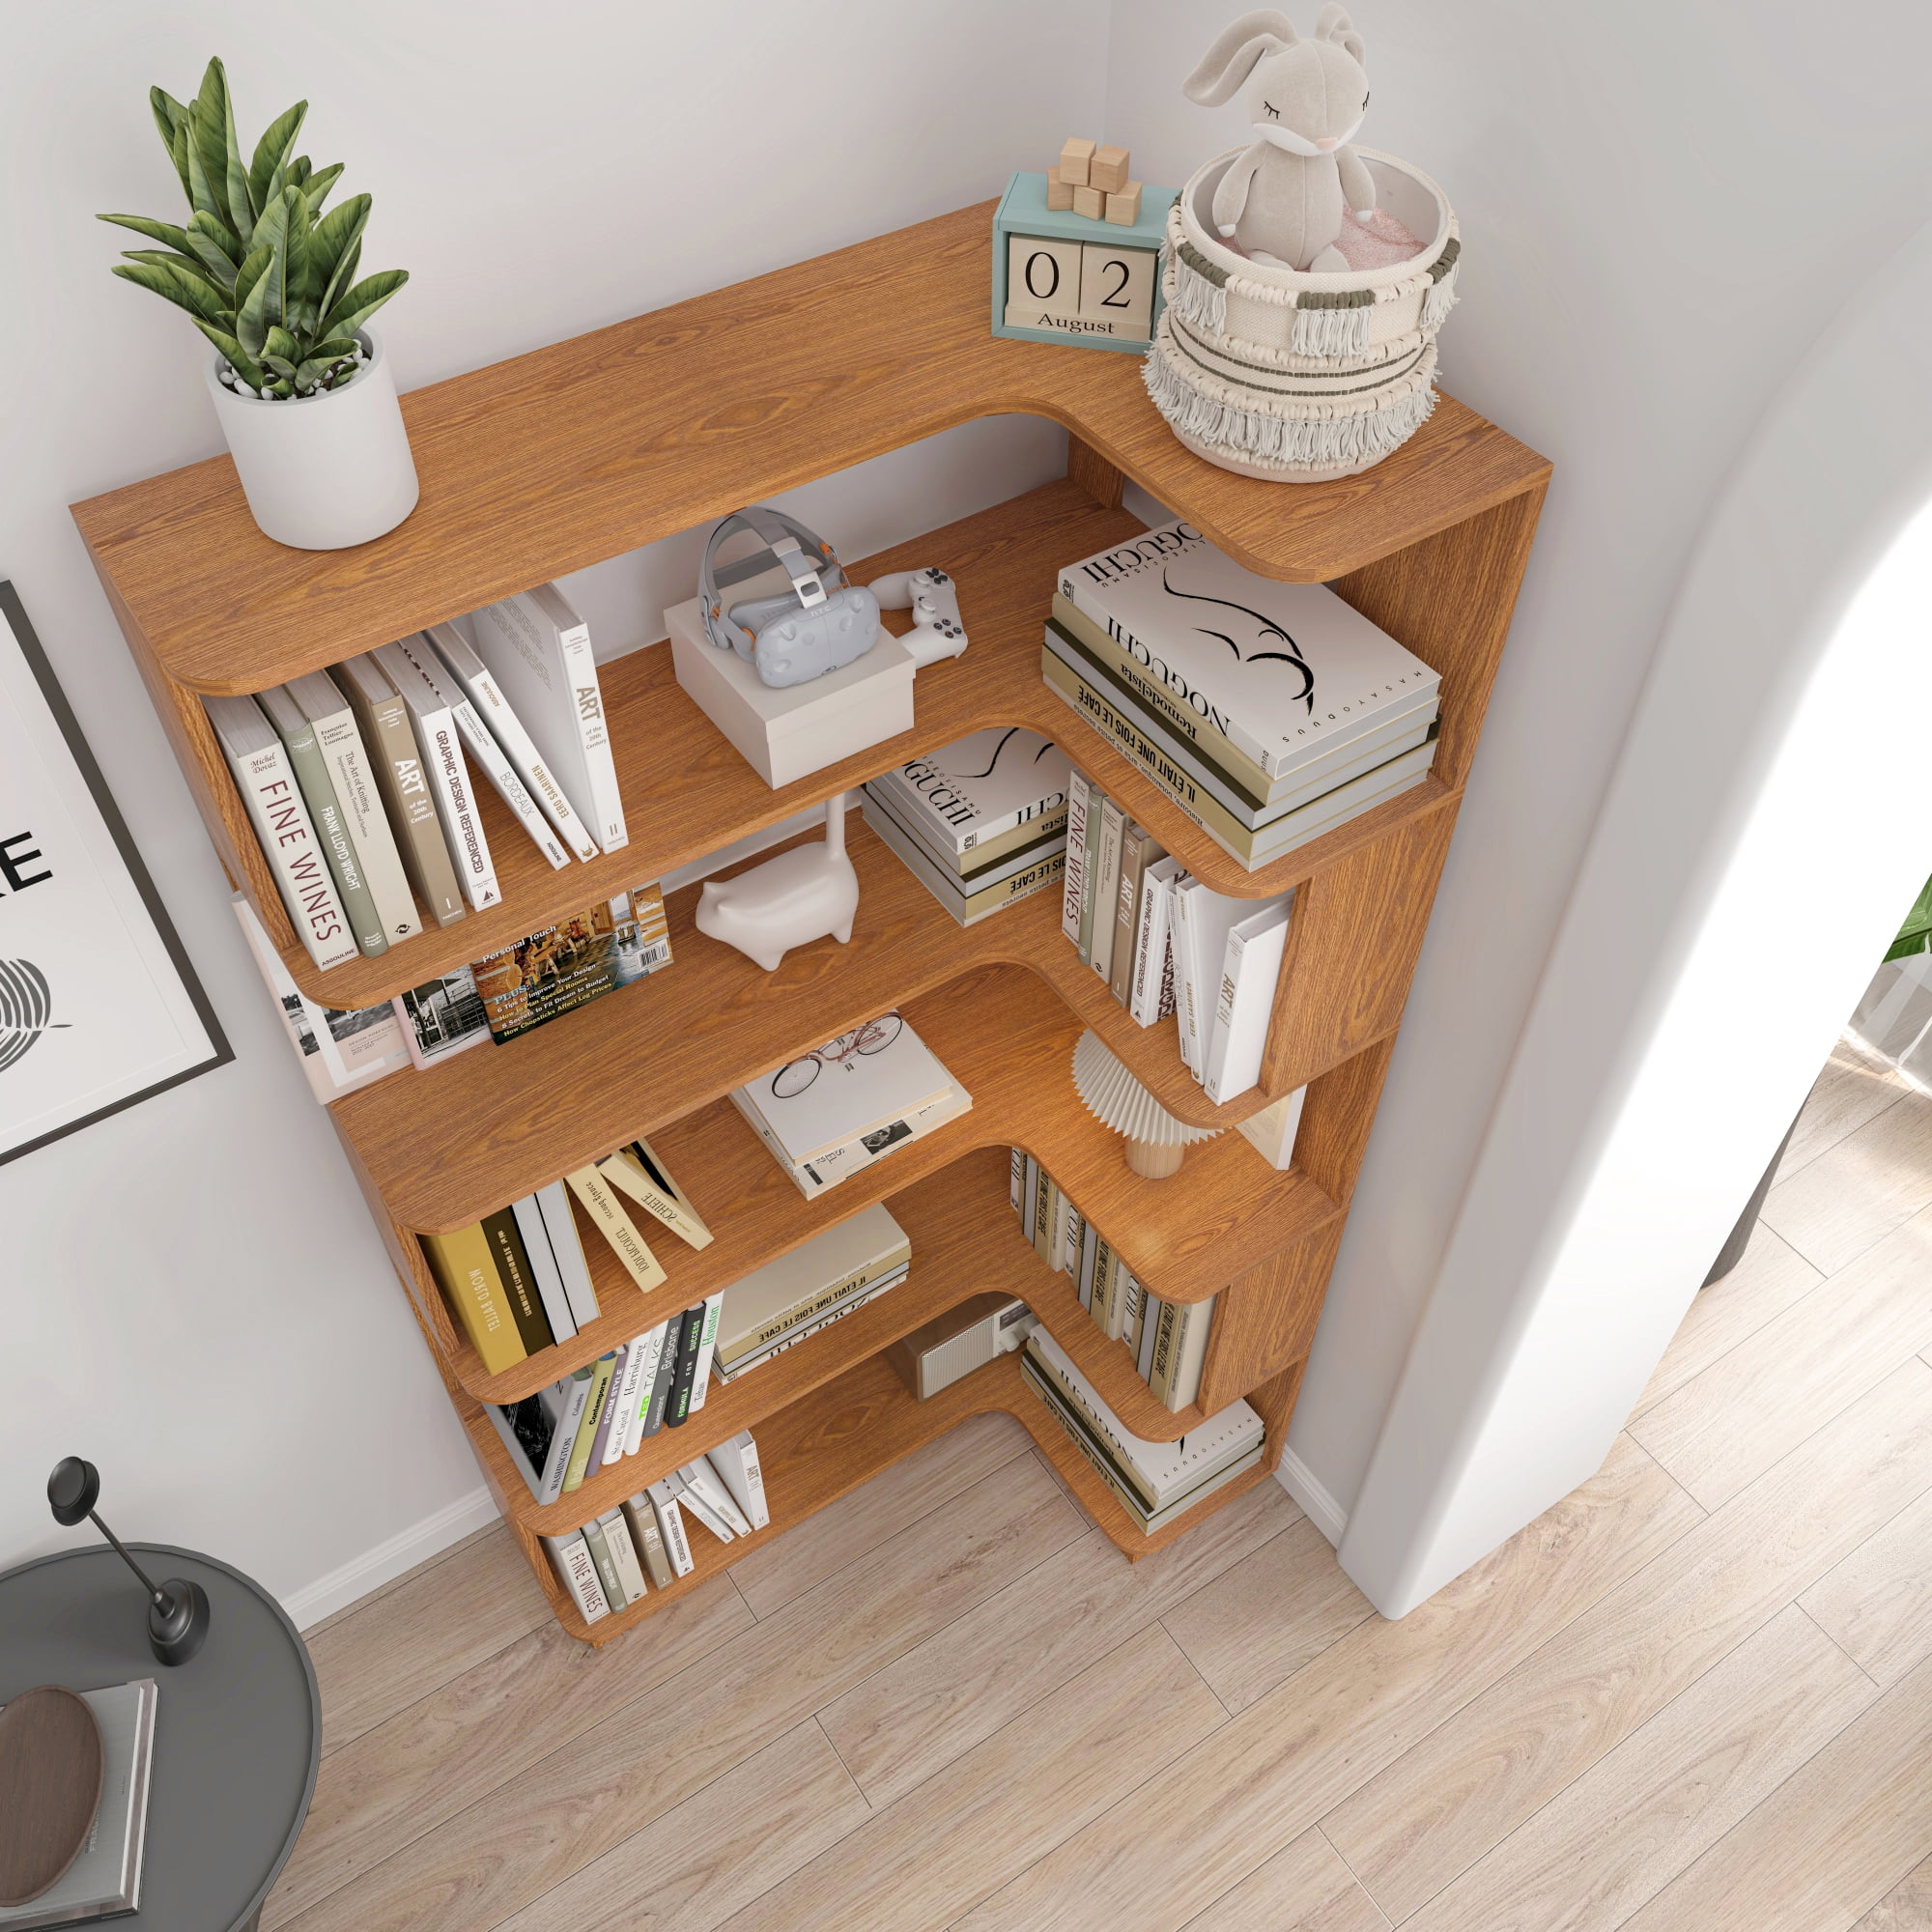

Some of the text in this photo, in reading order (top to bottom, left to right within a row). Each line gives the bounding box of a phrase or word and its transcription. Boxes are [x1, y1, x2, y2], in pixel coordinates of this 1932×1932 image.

[1037, 313, 1115, 334] August
[1081, 523, 1203, 583] OGUCHI
[1108, 615, 1232, 738] NOGUCHI
[1121, 663, 1198, 741] Remodelista
[576, 687, 601, 722] ART
[585, 727, 594, 736] of
[585, 738, 607, 750] Century
[1077, 685, 1196, 803] IL ÉTAIT UNE FOIS LE CAFÉ
[250, 752, 276, 770] Michel
[253, 760, 277, 774] Dovaz
[345, 751, 371, 814] The Art of Knitting
[394, 759, 425, 795] ART
[409, 802, 417, 810] of
[411, 810, 434, 825] Century
[412, 806, 428, 815] 20th
[436, 730, 458, 776] GRAPHIC
[449, 776, 467, 813] DESIGN
[459, 813, 485, 874] REFERENCED
[499, 771, 535, 818] BORDEAUX
[532, 764, 570, 819] EERO SAARINEN
[901, 759, 976, 827] GUCHI
[321, 806, 361, 892] FRANK LLOYD WRIGHT
[1070, 799, 1086, 853] FINE
[0, 831, 53, 892] E
[260, 780, 342, 941] FINE WINES
[1009, 863, 1050, 895] LE CAFÉ
[1066, 856, 1082, 925] WINES
[1118, 873, 1134, 908] ART
[322, 948, 355, 966] ASSOULINE
[483, 924, 557, 963] Personal Touch
[1137, 889, 1154, 997] GRAPHIC DESIGN REFERENCED
[494, 984, 530, 1006] PLUS:
[499, 1011, 515, 1021] How
[525, 998, 539, 1009] Plan
[540, 986, 564, 1003] Special
[565, 976, 588, 989] Rooms
[503, 982, 612, 1037] How Chopsticks Affect Log Prices
[504, 1000, 519, 1011] Tips
[528, 982, 556, 999] Improve
[556, 975, 572, 985] Your
[573, 963, 596, 978] Design
[508, 1009, 534, 1026] Secrets
[544, 1000, 554, 1009] Fit
[554, 990, 577, 1005] Dream
[585, 974, 610, 990] Budget
[1220, 974, 1236, 1009] ART
[661, 1325, 679, 1372] Brisbane
[702, 1305, 720, 1347] Houston
[624, 1342, 648, 1397] Harrisburg
[639, 1336, 665, 1420] TED TALKS
[677, 1386, 690, 1418] FORMULA
[688, 1320, 701, 1352] SUCCESS
[604, 1367, 624, 1425] FORM STYLE
[550, 1436, 573, 1492] WASHINGTON
[569, 1552, 603, 1613] FINE WINES
